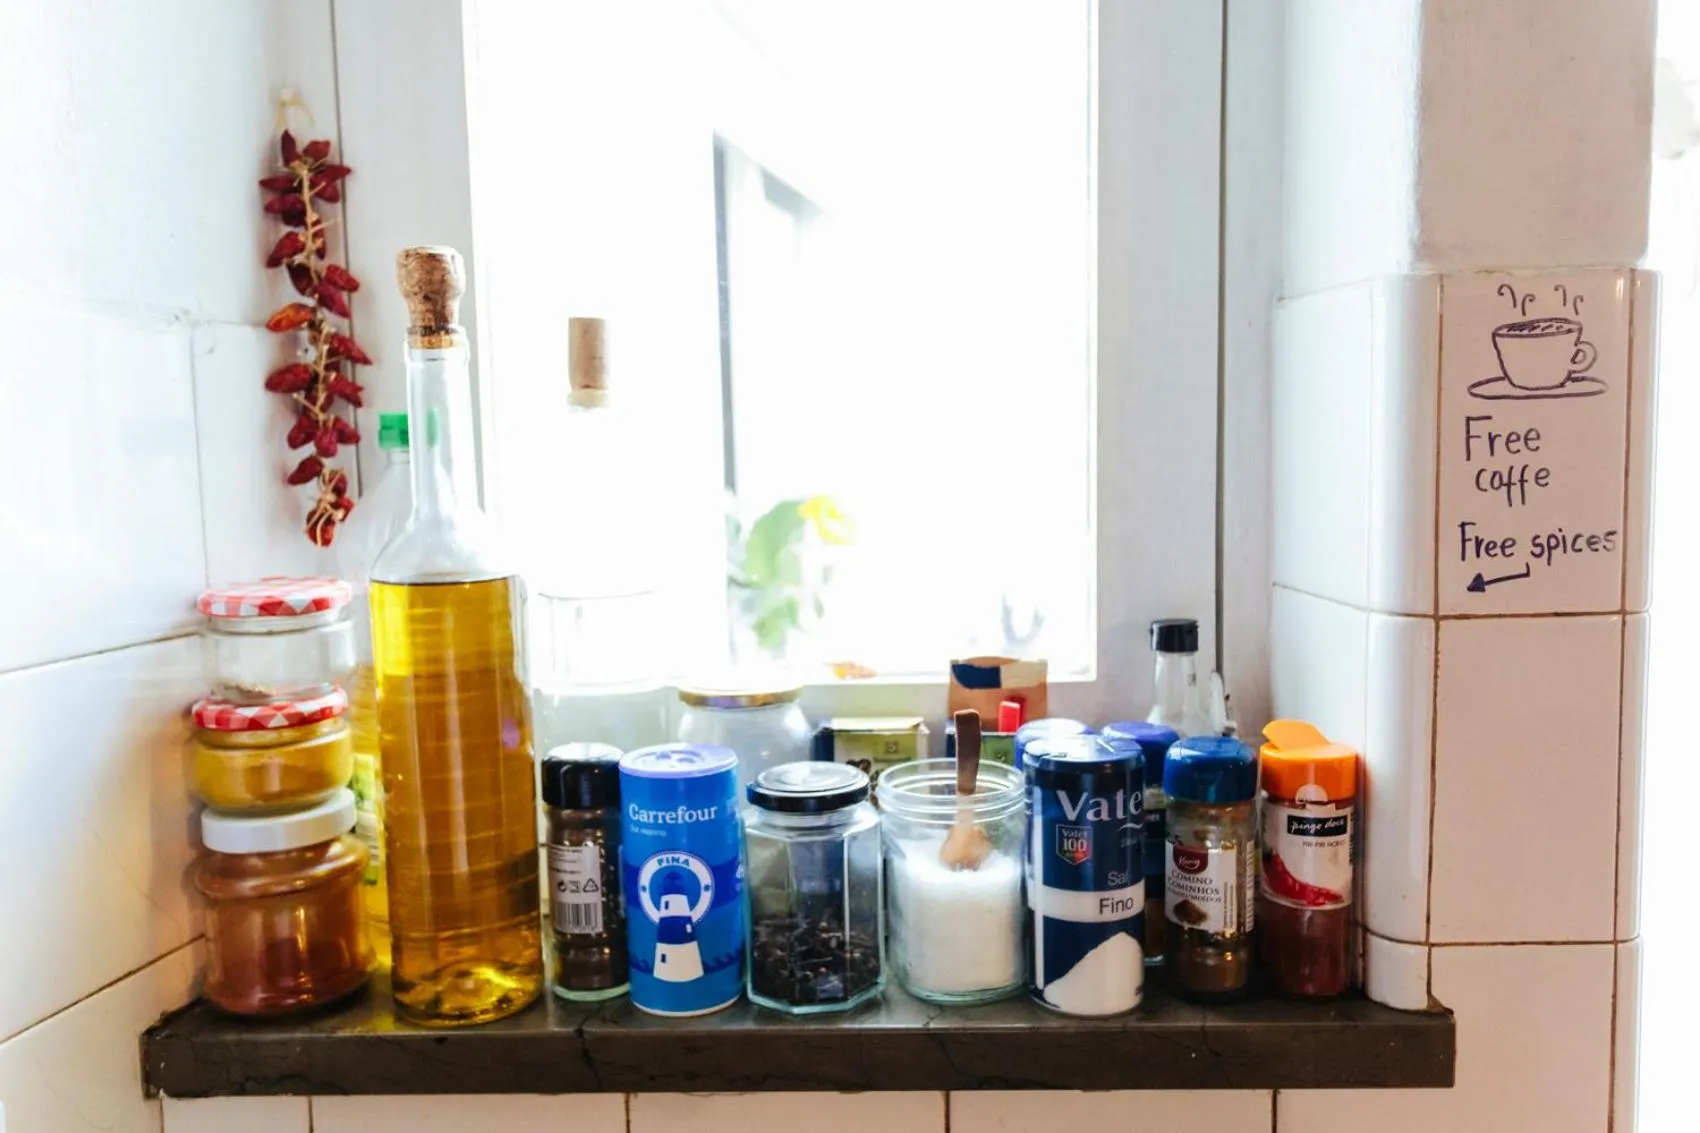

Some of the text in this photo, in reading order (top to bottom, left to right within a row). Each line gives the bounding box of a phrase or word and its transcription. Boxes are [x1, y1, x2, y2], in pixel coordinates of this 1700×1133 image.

[1465, 415, 1541, 461] Free
[1458, 521, 1618, 566] Free spices
[629, 803, 718, 824] Carrefour
[1056, 788, 1142, 821] Vate
[1063, 838, 1087, 852] 100
[657, 856, 690, 867] FINA
[1168, 875, 1220, 896] COMINHOS
[1171, 869, 1213, 885] COMINO
[1099, 897, 1134, 914] Fino
